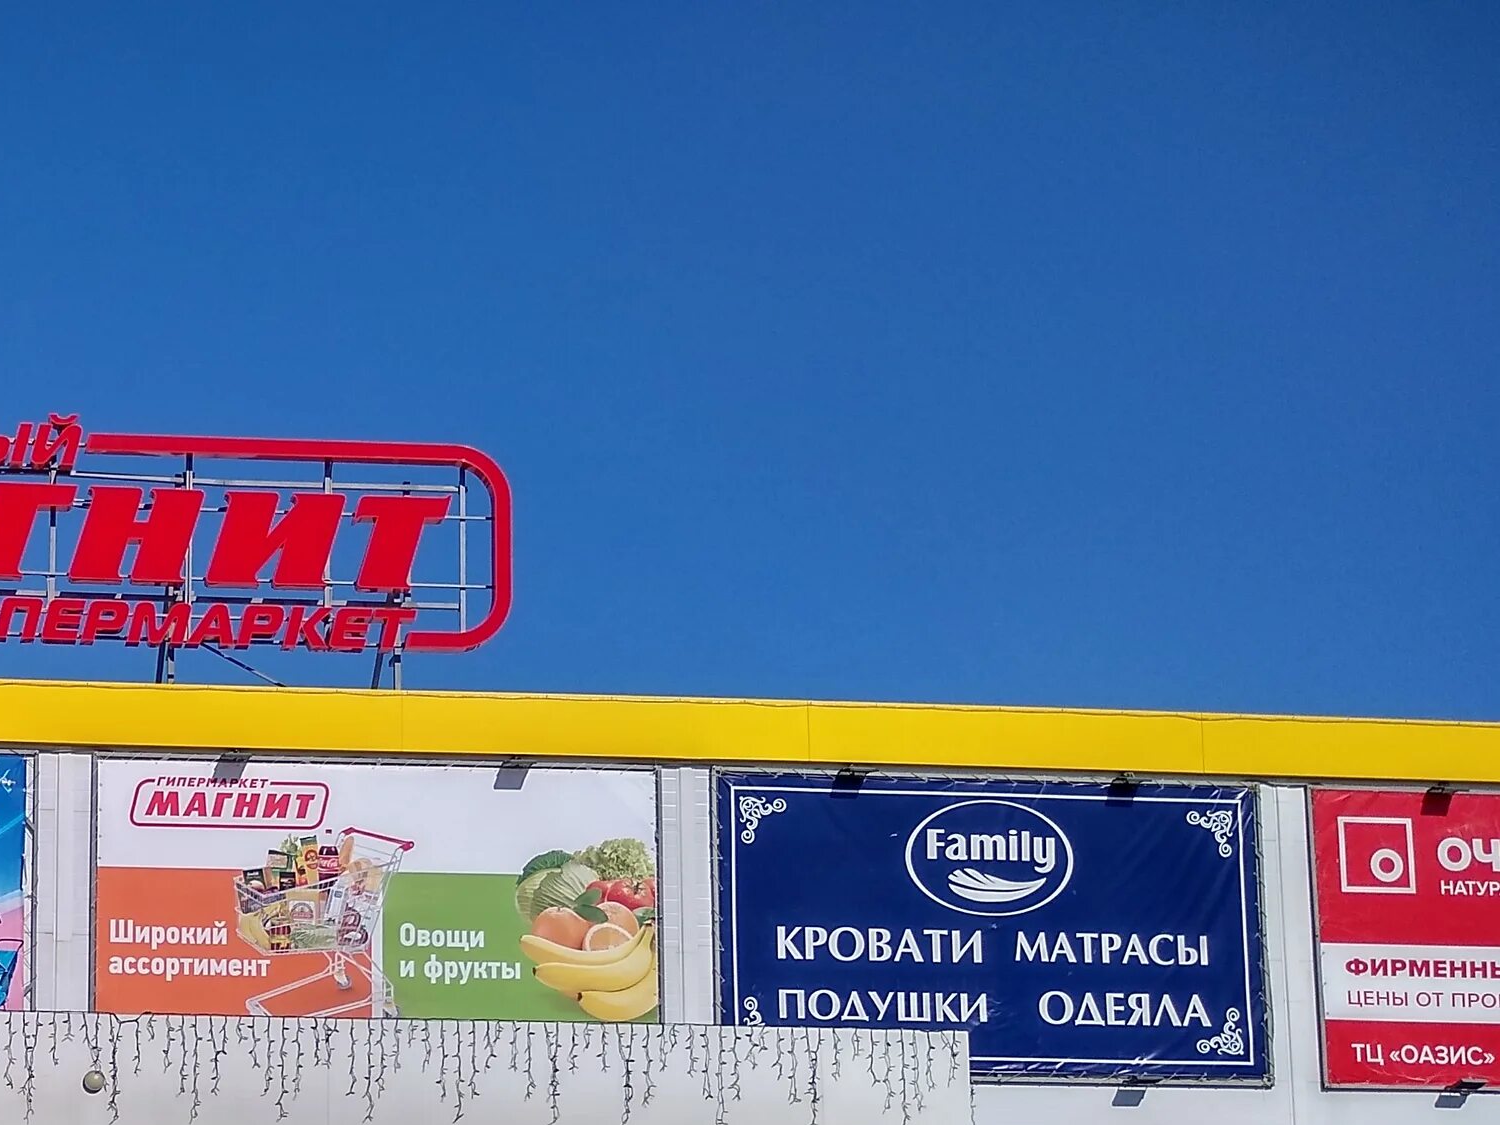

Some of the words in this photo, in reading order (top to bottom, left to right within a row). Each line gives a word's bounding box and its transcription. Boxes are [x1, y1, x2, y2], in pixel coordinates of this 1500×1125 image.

[156, 776, 269, 789] ГИПЕРМАРКЕТ
[145, 791, 316, 819] МАГНИТ
[926, 828, 1056, 874] Family
[108, 918, 229, 953] Широкий
[399, 922, 485, 952] Овощи
[776, 926, 984, 964] КРОВАТИ
[1015, 931, 1210, 967] МАТРАСЫ
[108, 957, 271, 984] ассортимент
[399, 958, 416, 980] и
[423, 954, 523, 985] фрукты
[778, 988, 989, 1024] ПОДУШКИ
[1038, 991, 1212, 1028] ОДЕЯЛА
[1347, 990, 1409, 1008] ЦЕНЫ
[1416, 991, 1444, 1008] ОТ
[1451, 993, 1500, 1009] ПРО
[1351, 1043, 1385, 1066] ТЦ
[1389, 1044, 1495, 1066] «ОАЗИС»
